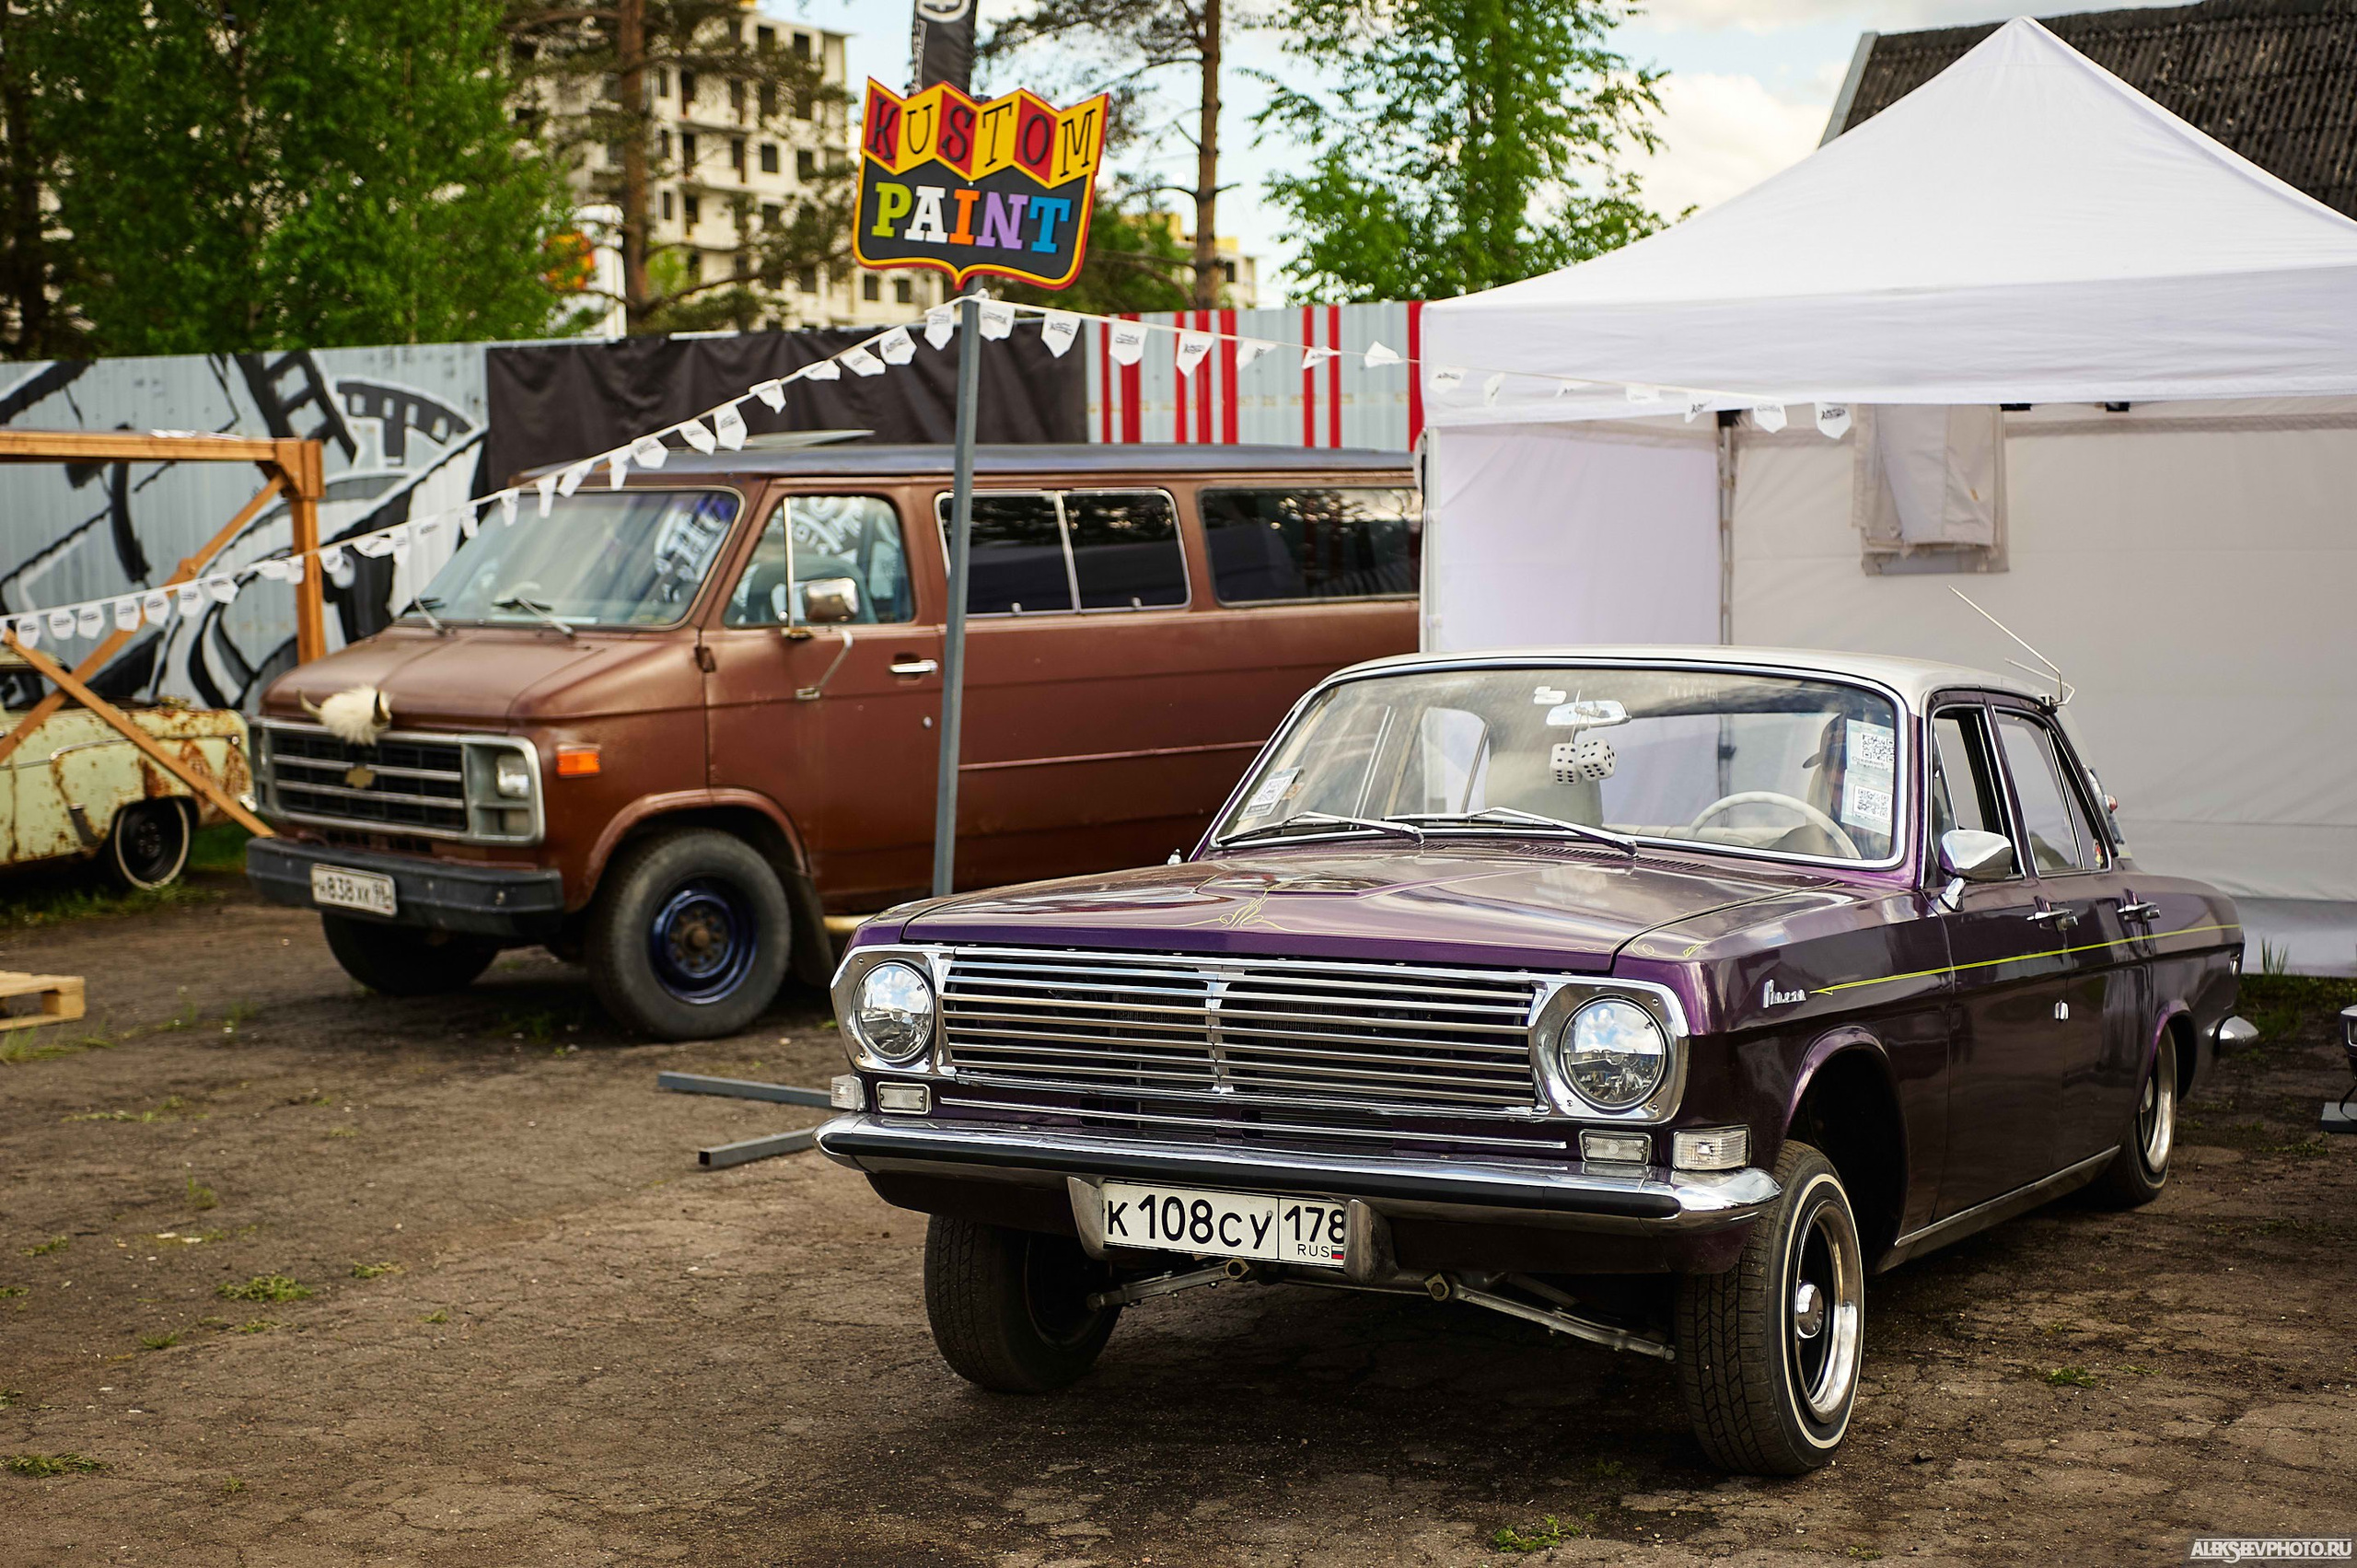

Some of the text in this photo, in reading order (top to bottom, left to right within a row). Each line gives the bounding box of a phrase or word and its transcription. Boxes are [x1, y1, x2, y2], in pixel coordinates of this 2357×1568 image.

[868, 95, 1097, 177] KUSTOM
[871, 181, 1073, 253] PAINT
[1283, 1205, 1344, 1243] 178
[1297, 1243, 1329, 1258] RUS
